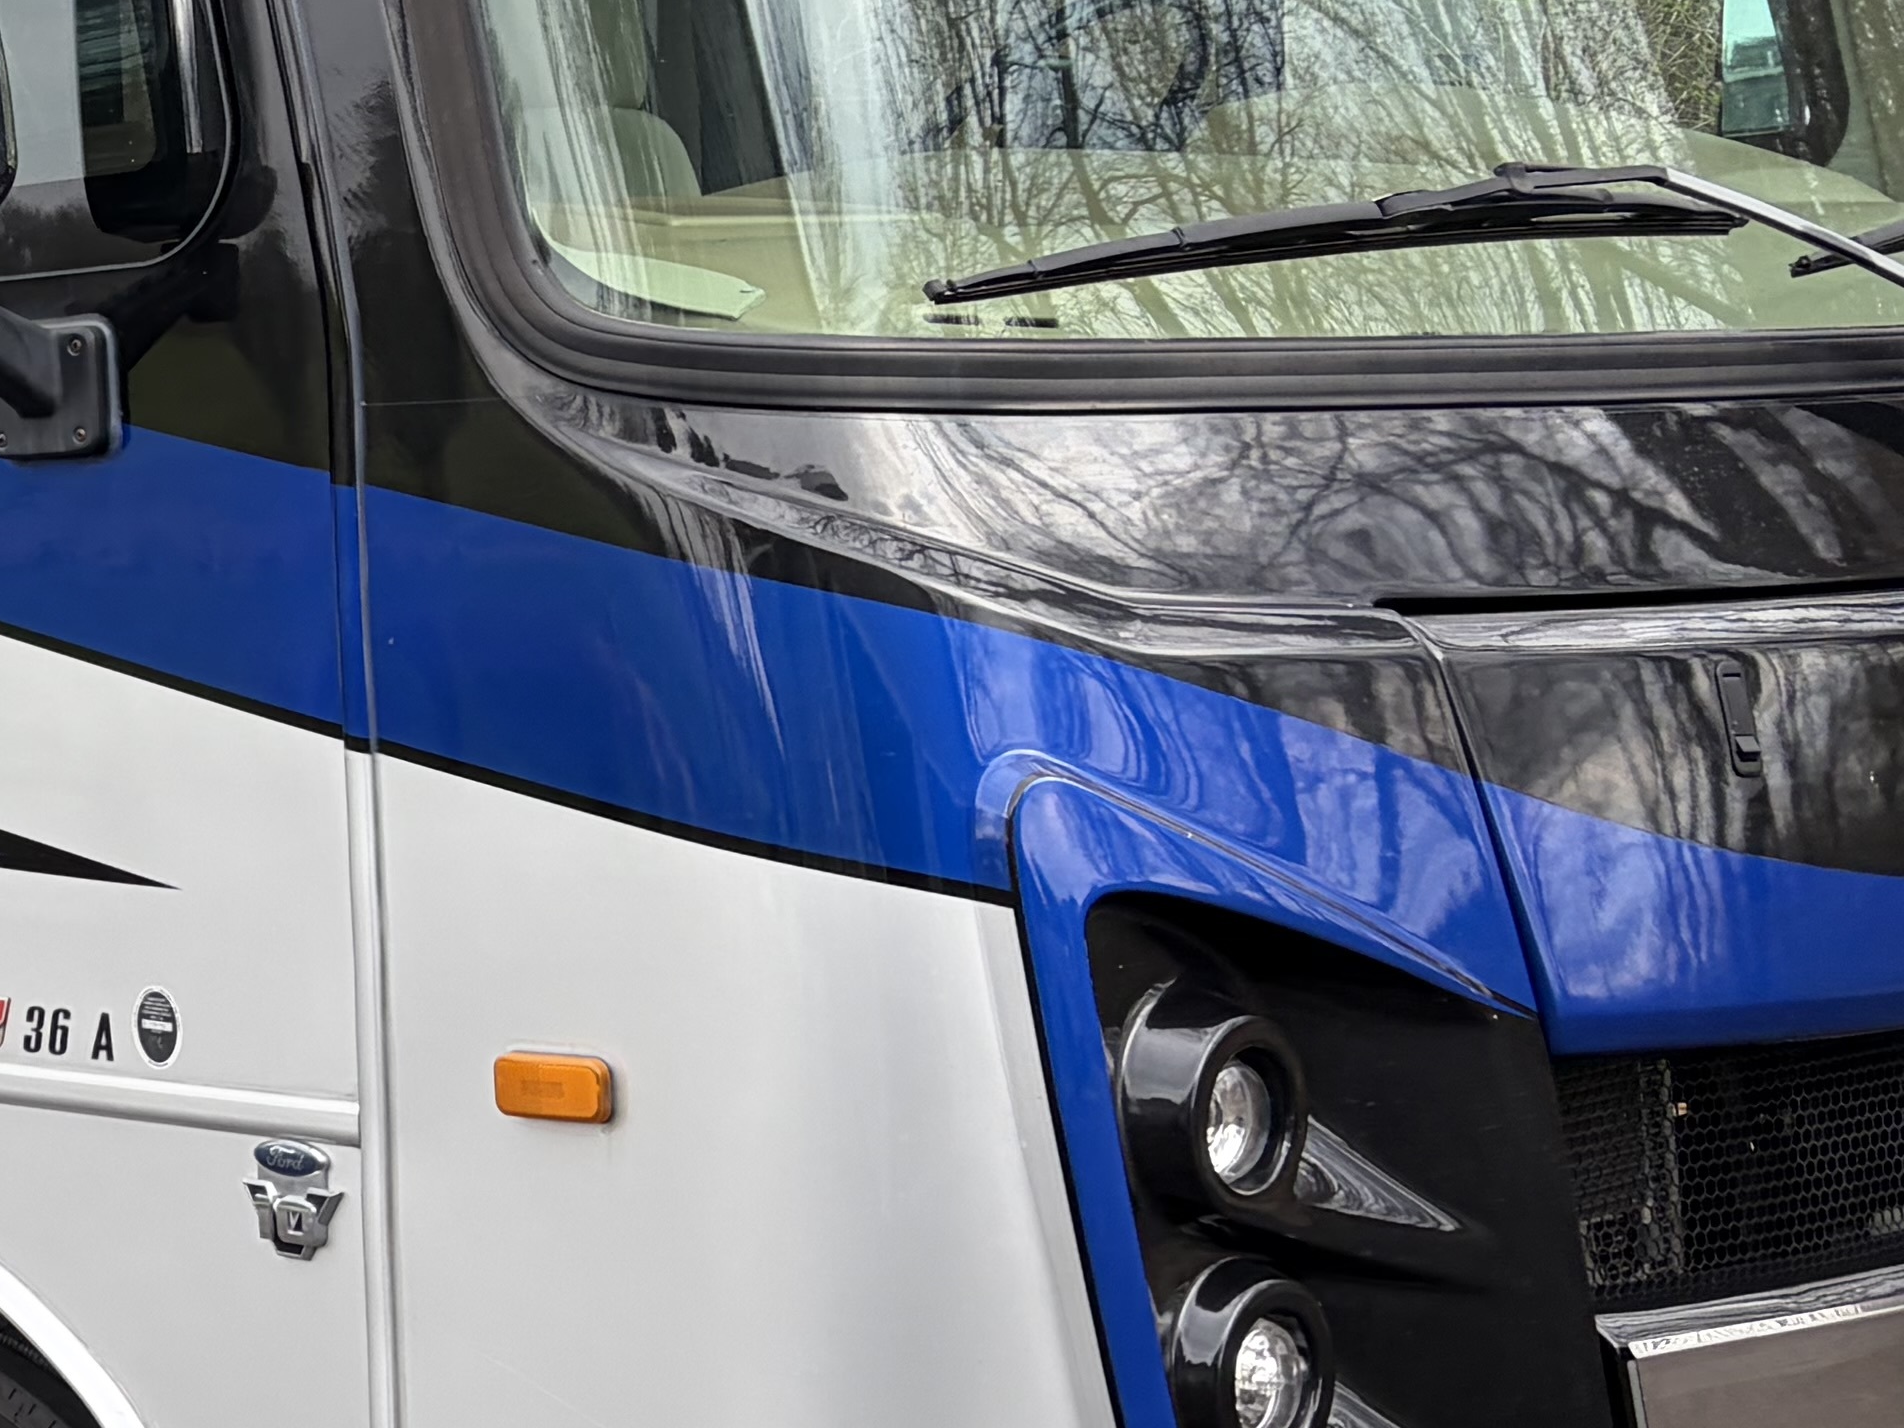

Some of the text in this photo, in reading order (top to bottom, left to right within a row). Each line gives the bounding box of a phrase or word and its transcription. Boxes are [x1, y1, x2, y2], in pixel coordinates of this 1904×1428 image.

[23, 1006, 71, 1055] 36
[91, 1012, 114, 1061] A
[266, 1145, 304, 1170] Ford
